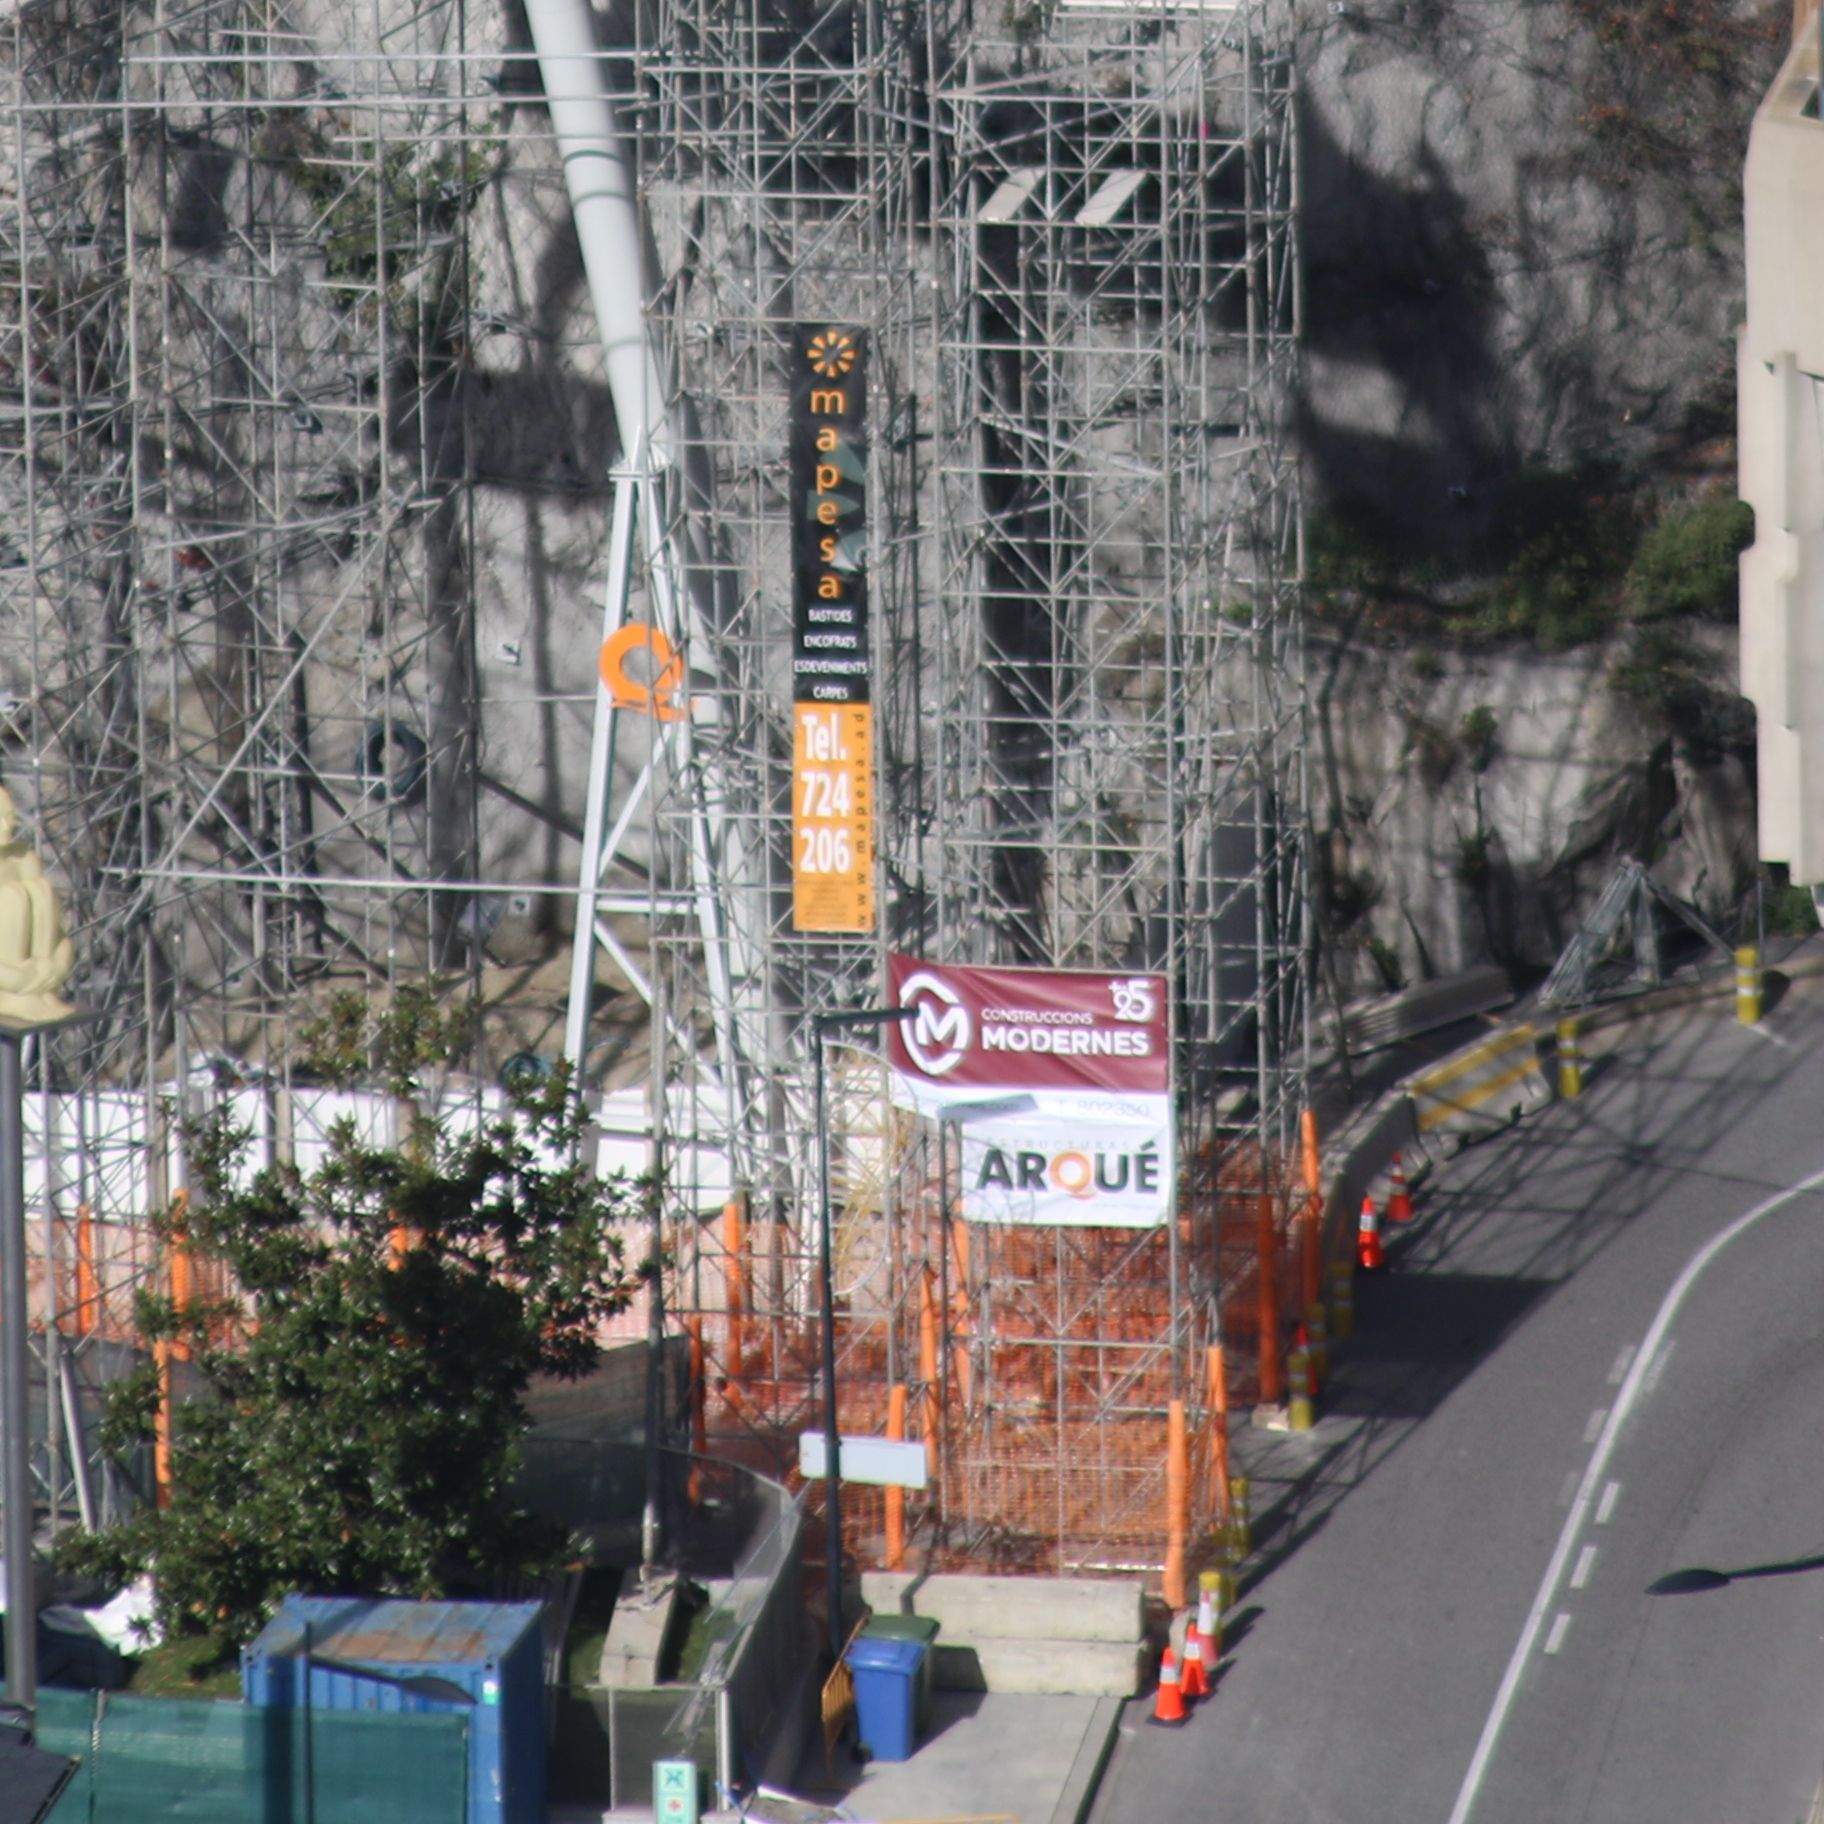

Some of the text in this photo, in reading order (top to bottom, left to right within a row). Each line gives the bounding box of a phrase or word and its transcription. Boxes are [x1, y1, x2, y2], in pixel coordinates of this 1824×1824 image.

[809, 388, 846, 600] mapesa
[808, 609, 853, 623] BASTIDES
[803, 635, 857, 649] ENCOFRATS
[813, 686, 849, 700] CARPES
[800, 712, 848, 761] Tel.
[800, 771, 851, 818] 724
[854, 712, 867, 928] www.mapesa.ad
[800, 827, 852, 874] 206
[980, 1007, 1093, 1025] CONSTRUCCIONS
[981, 1026, 1150, 1056] MODERNES
[976, 1139, 1160, 1200] ARQUÉ
